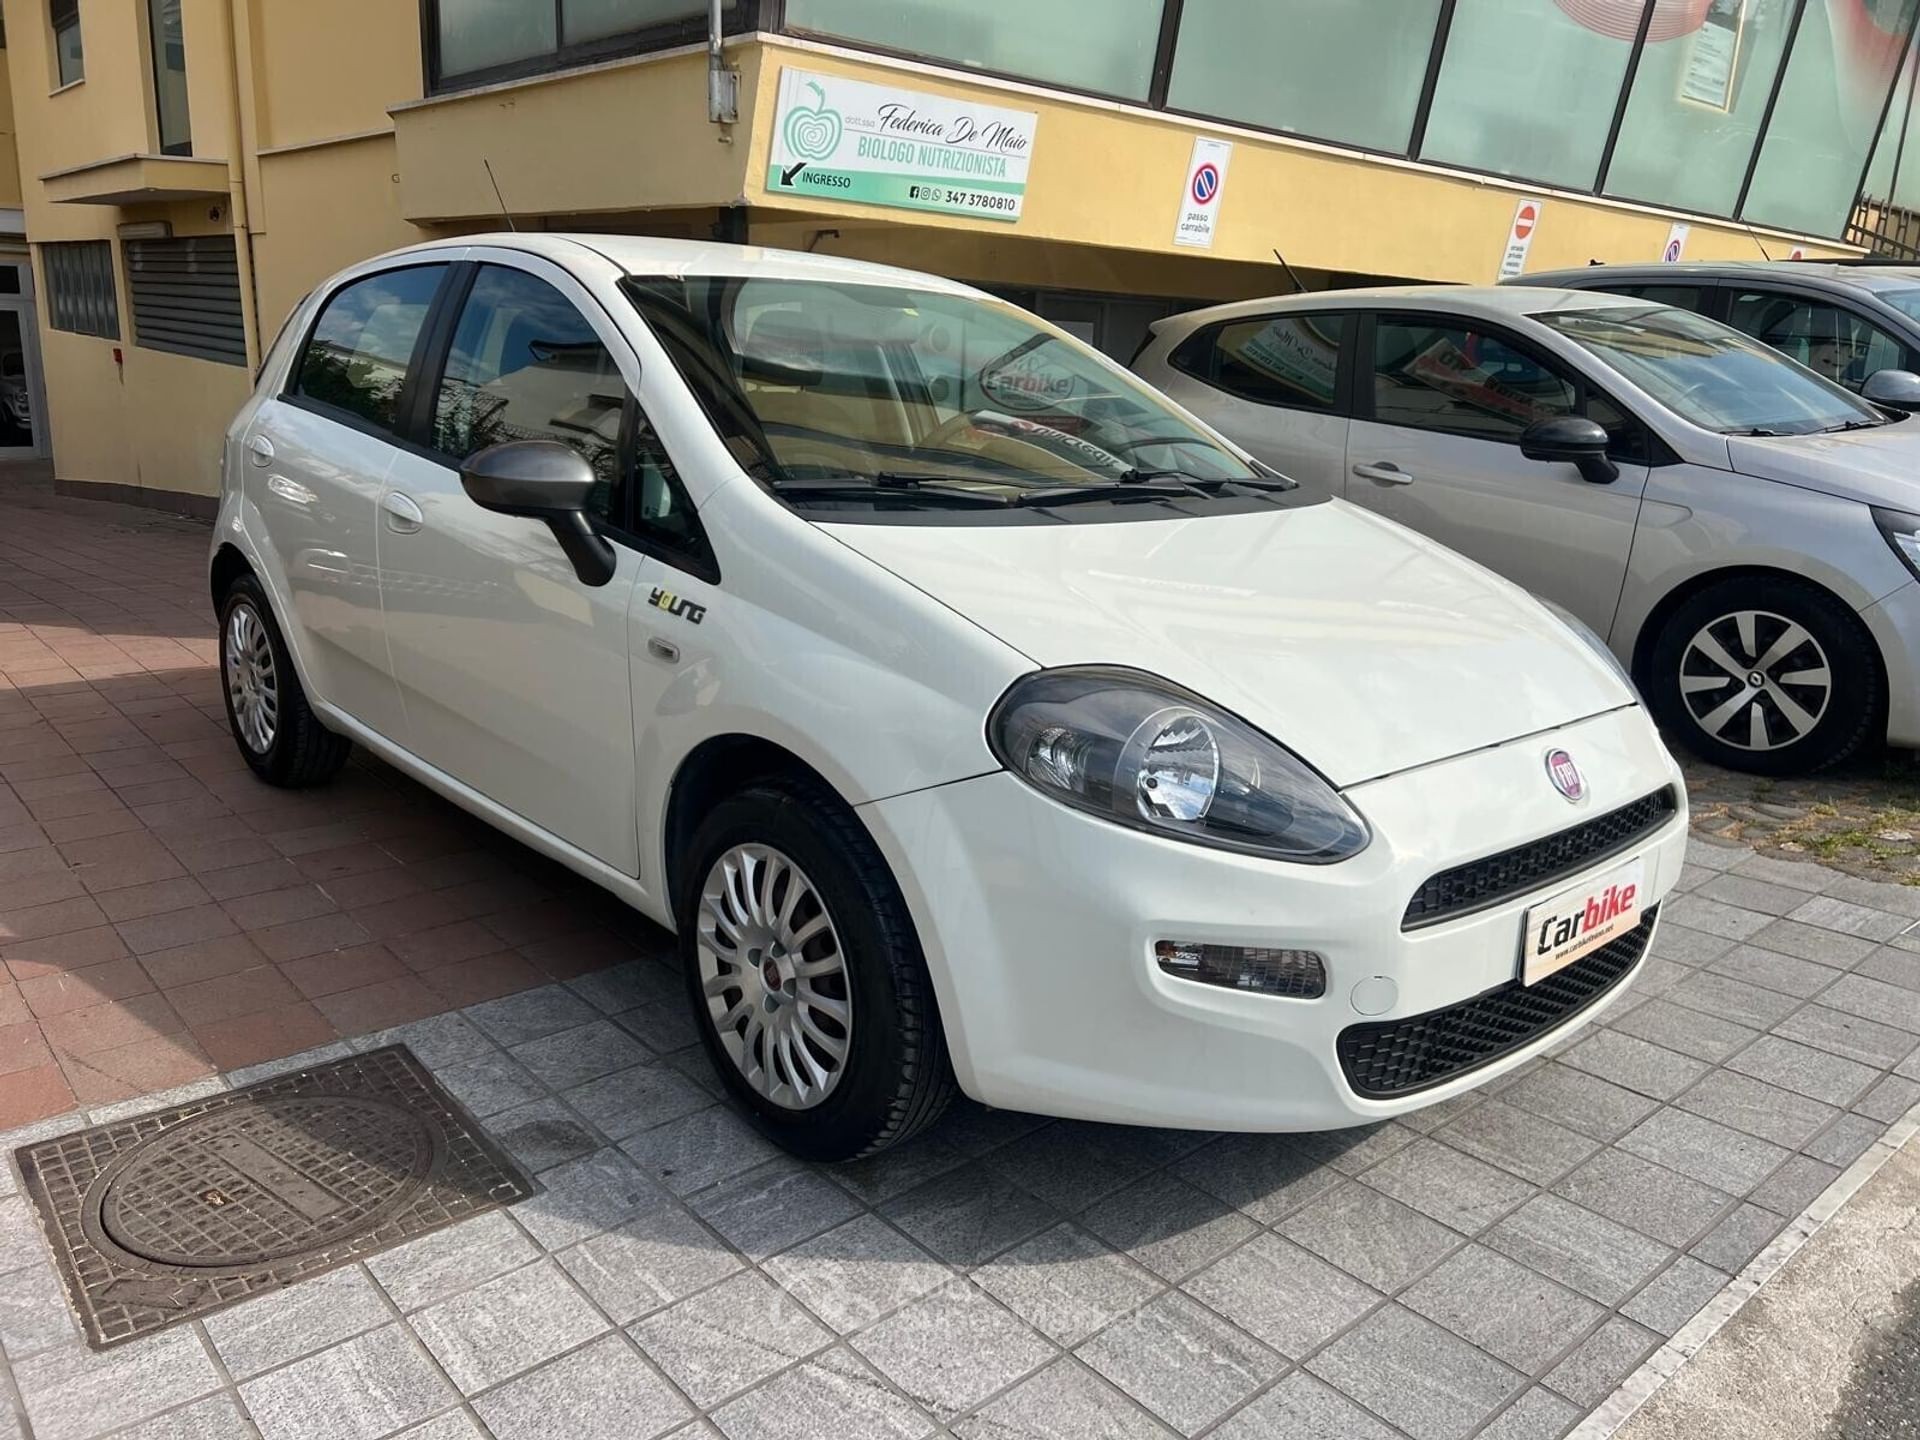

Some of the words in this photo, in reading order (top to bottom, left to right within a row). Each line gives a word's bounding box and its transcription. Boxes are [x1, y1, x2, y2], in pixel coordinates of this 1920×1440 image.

[878, 103, 944, 137] Federica
[945, 116, 978, 144] De
[981, 121, 1027, 153] Maio
[857, 135, 915, 164] BIOLOGO
[917, 144, 1007, 178] NUTRIZIONISTA
[802, 171, 851, 189] INGRESSO
[945, 190, 967, 205] 347
[968, 194, 1016, 211] 3780810
[1181, 223, 1210, 233] carrabile
[1187, 212, 1208, 222] passo
[648, 587, 707, 625] YOUNG
[1536, 883, 1636, 956] Carbike
